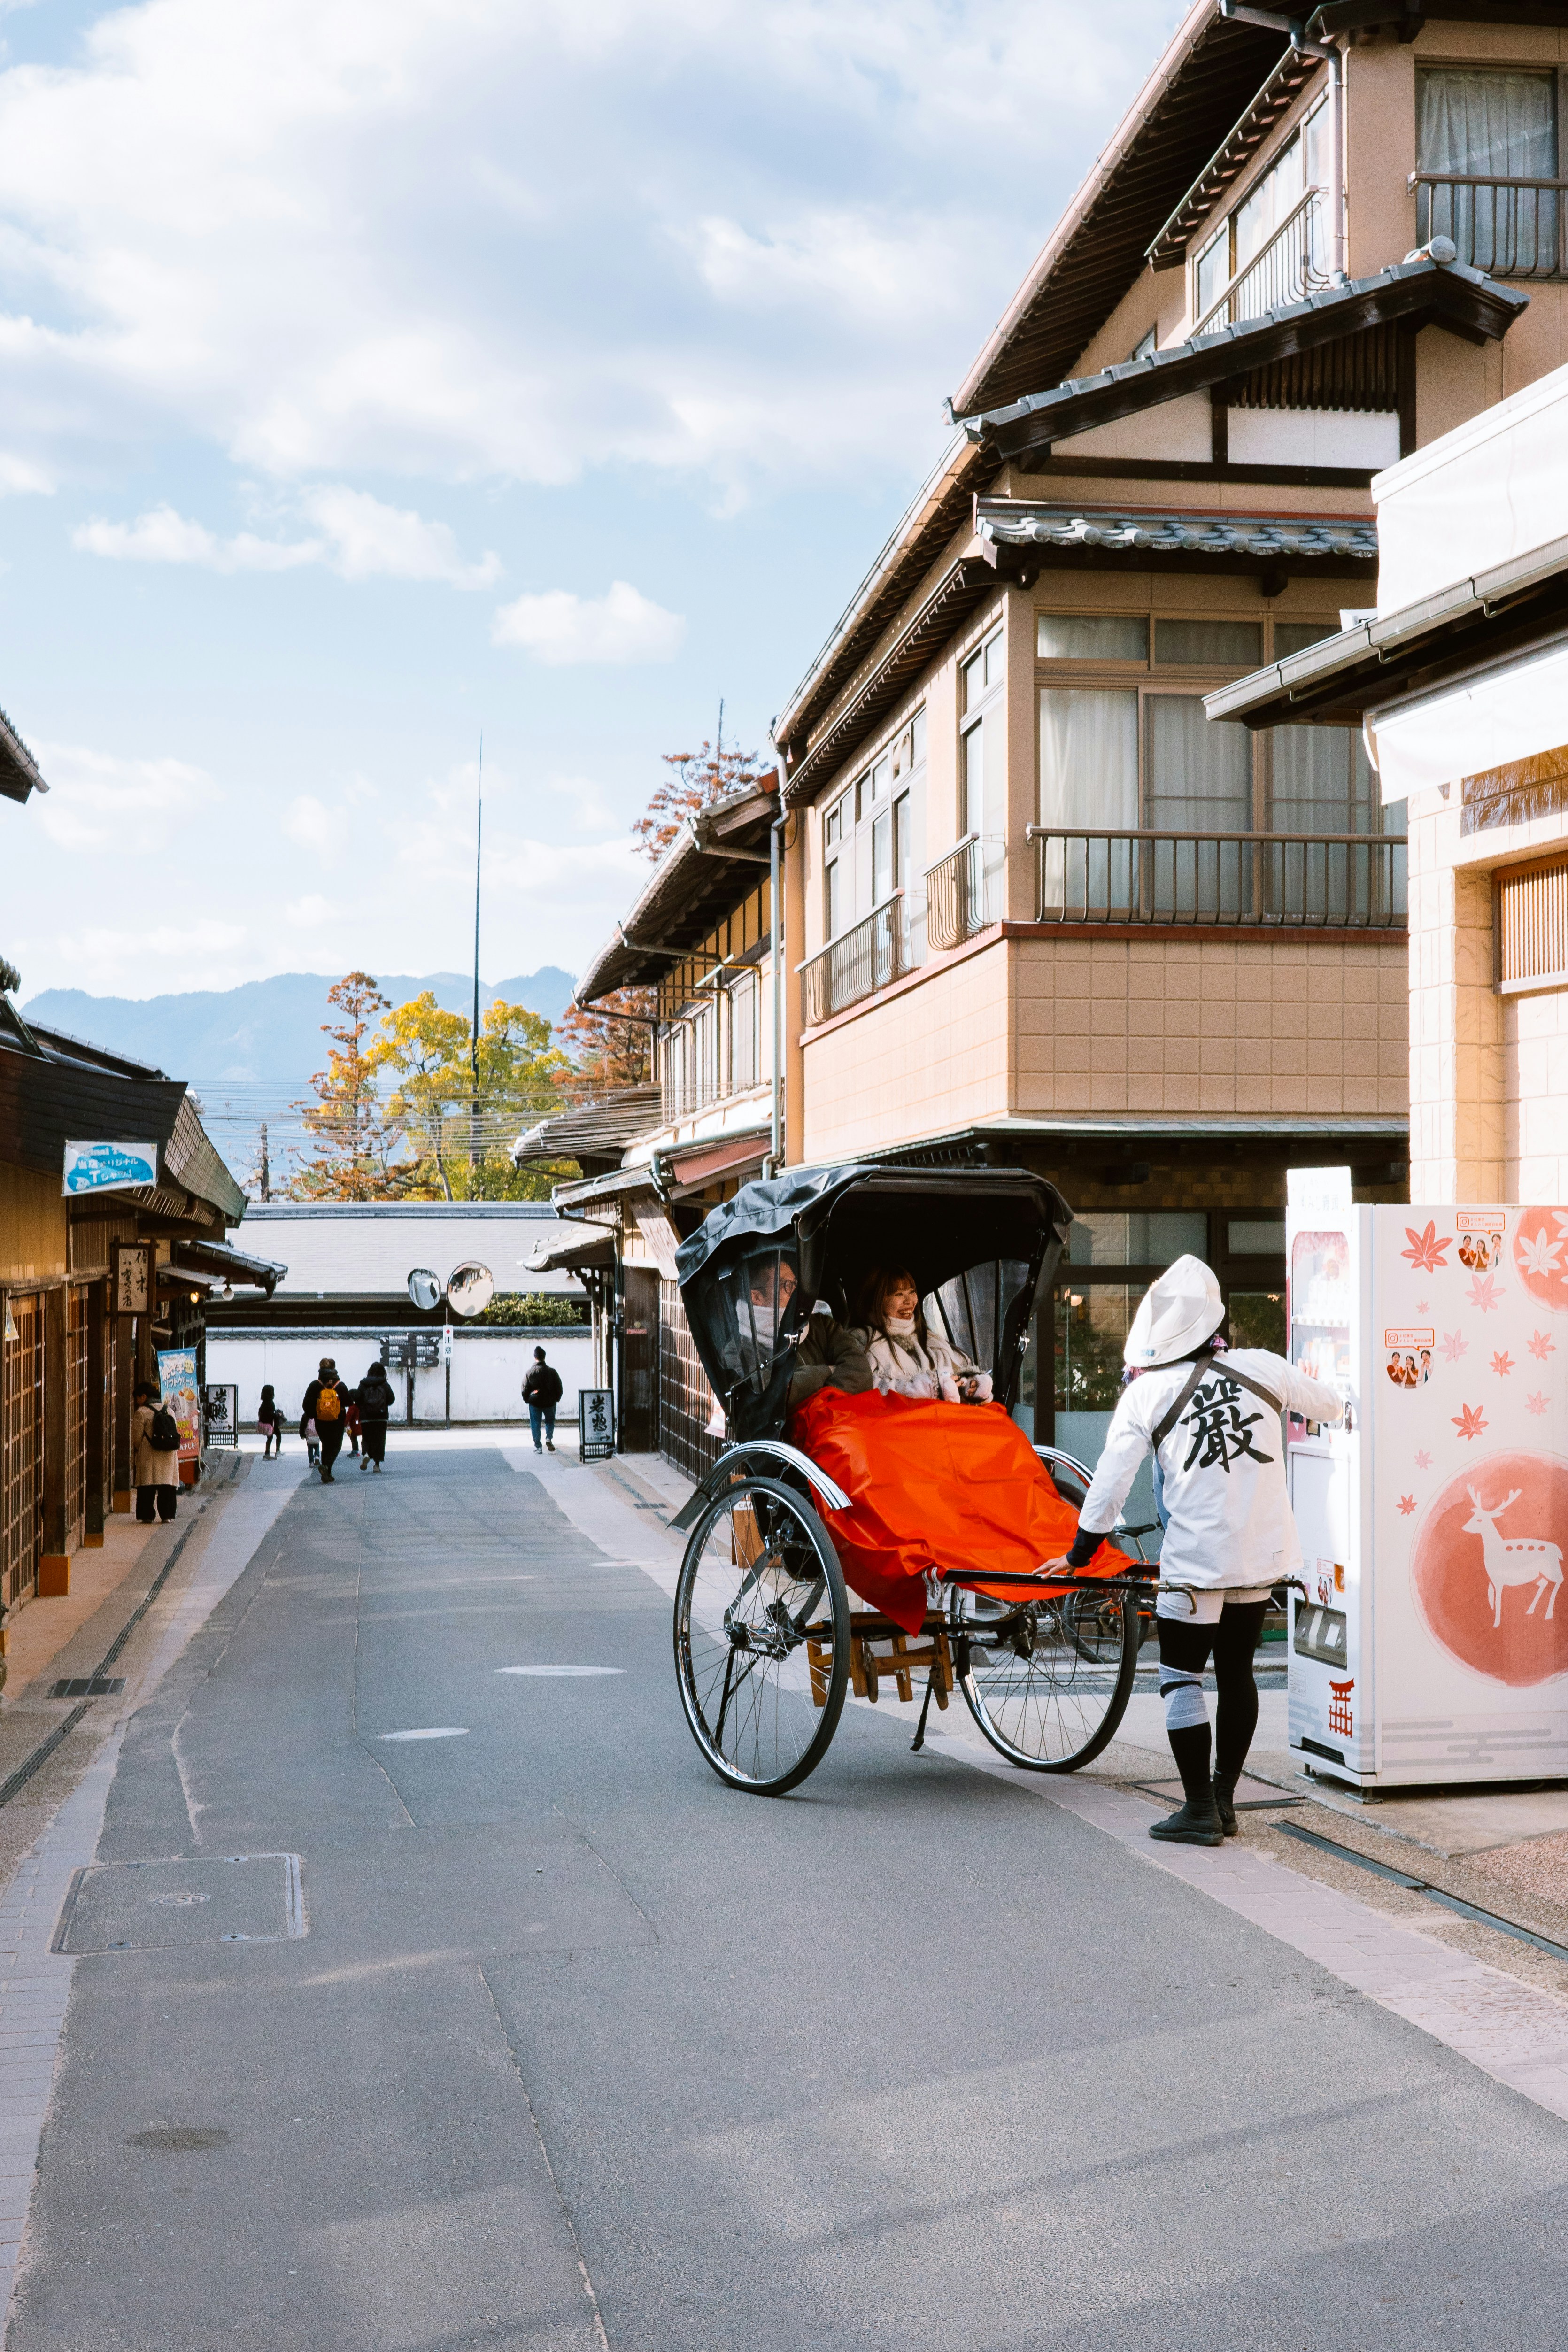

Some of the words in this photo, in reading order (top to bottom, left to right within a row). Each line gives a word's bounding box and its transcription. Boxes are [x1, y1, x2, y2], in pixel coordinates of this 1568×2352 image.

[164, 1376, 194, 1390] ソフトクリーム
